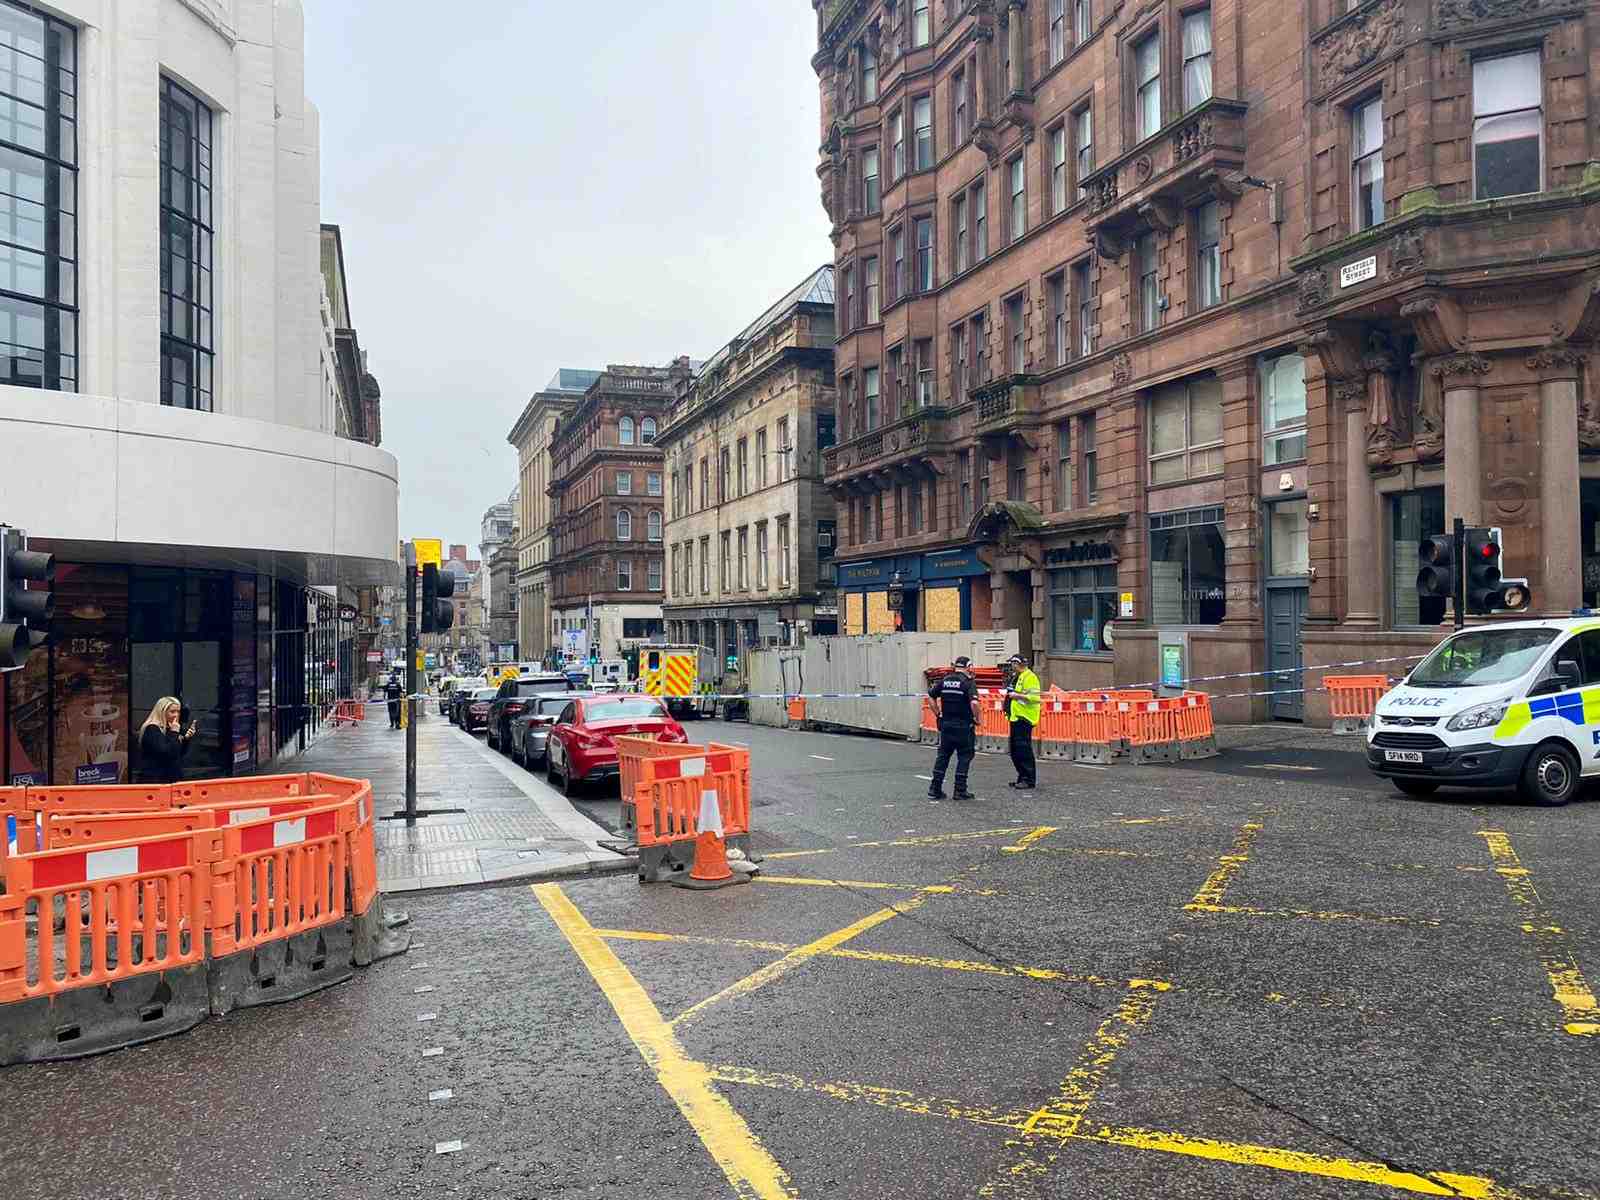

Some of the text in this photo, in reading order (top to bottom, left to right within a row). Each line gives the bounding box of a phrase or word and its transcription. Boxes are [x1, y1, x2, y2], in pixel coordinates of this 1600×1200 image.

[1343, 259, 1374, 274] RENFIELD
[1346, 267, 1370, 280] STREET
[1389, 697, 1447, 707] POLICE
